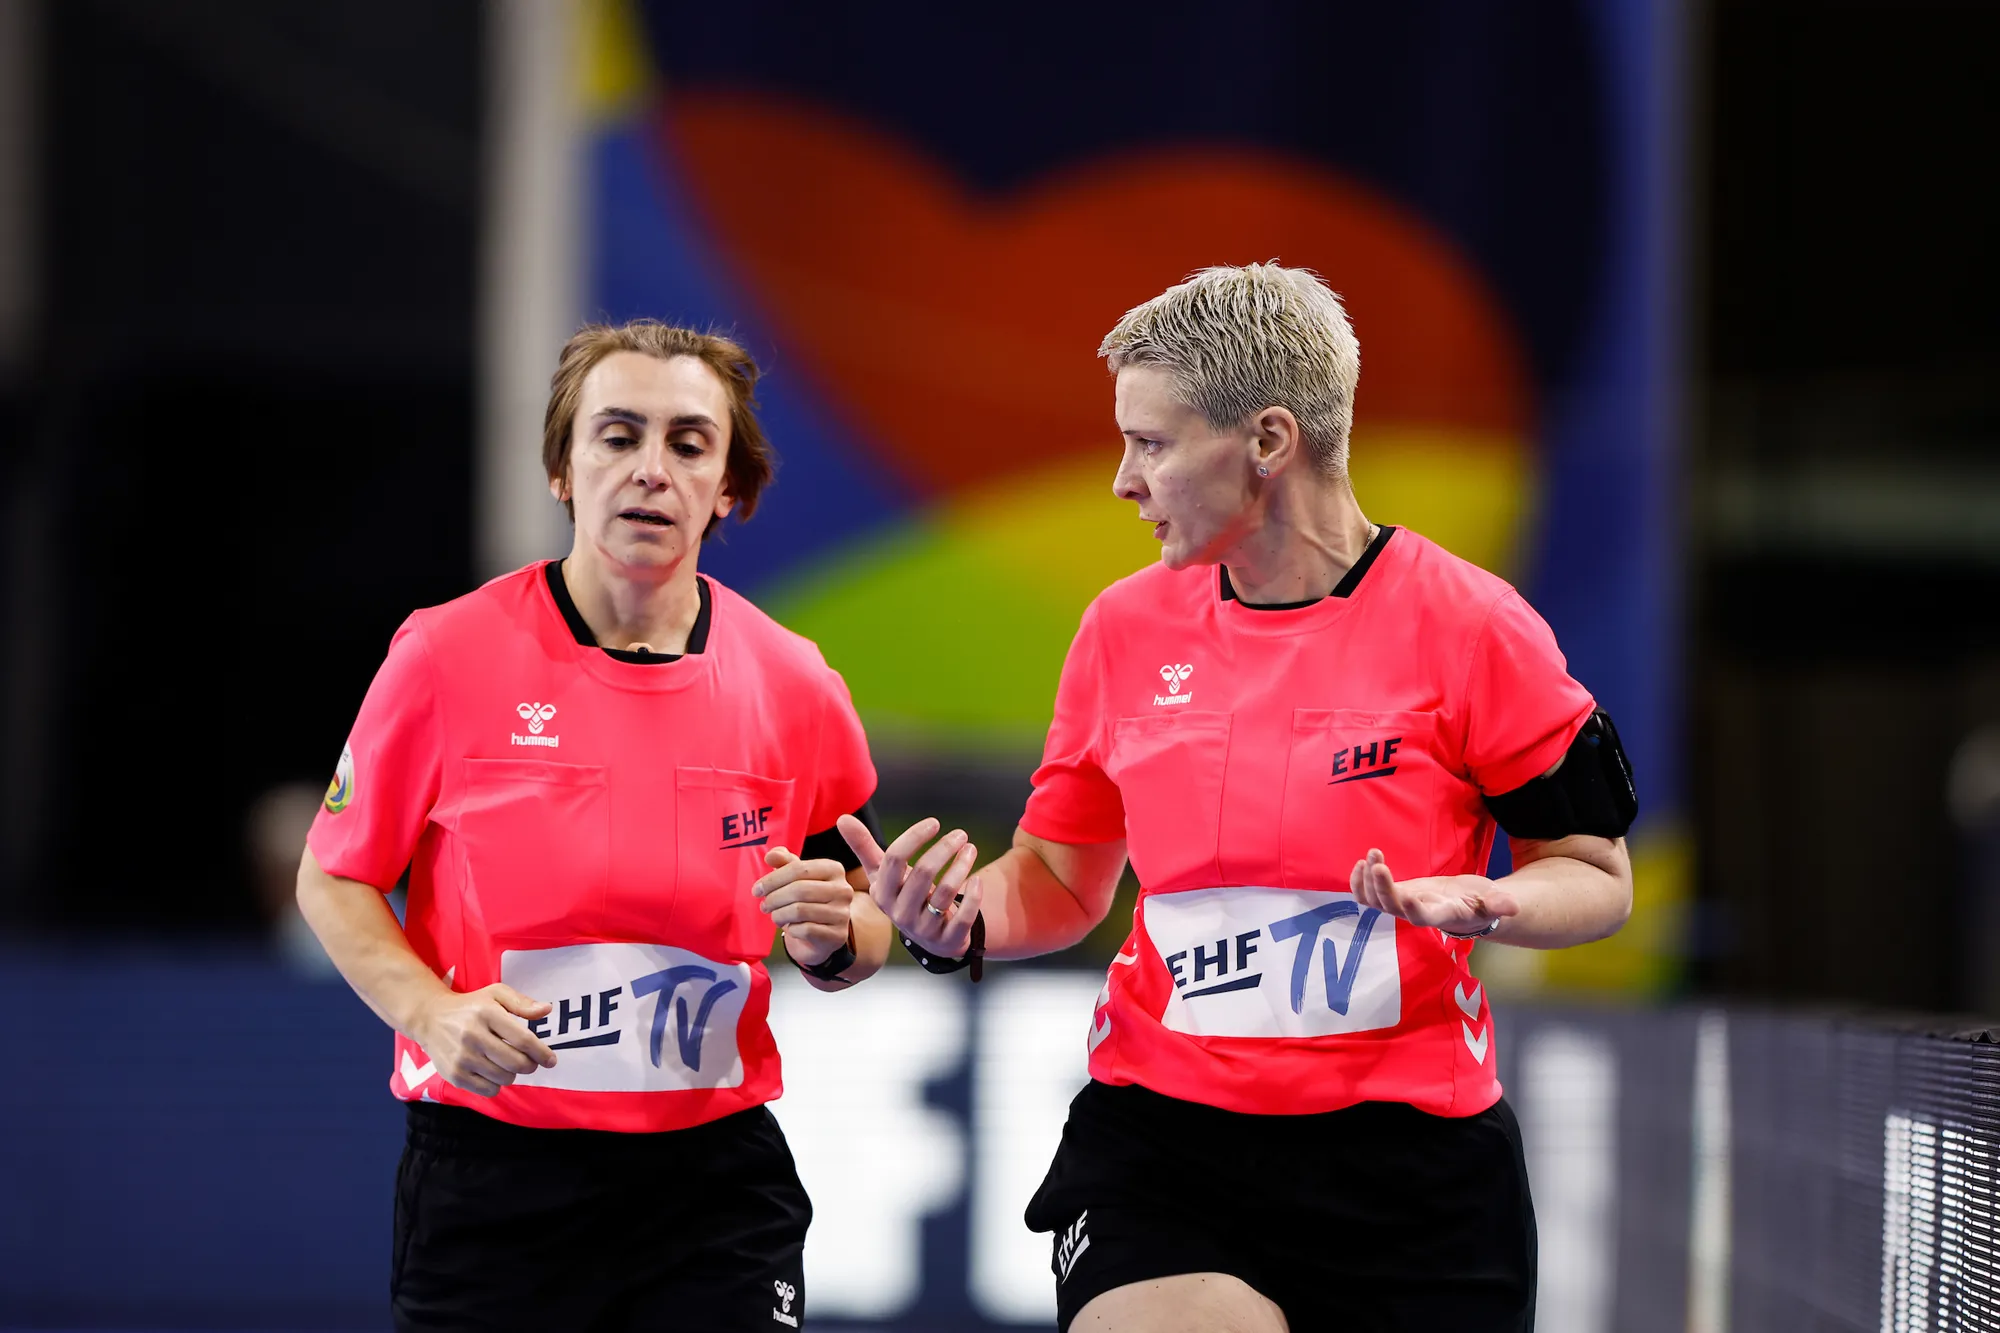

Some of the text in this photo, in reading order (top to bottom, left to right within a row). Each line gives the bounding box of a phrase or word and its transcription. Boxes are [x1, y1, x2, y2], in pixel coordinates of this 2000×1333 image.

[1153, 691, 1192, 706] hummel
[511, 732, 559, 748] hummel
[1331, 738, 1402, 776] EHF
[722, 806, 773, 842] EHF
[1166, 900, 1382, 1016] EHF TV
[631, 965, 738, 1072] TV
[1058, 1209, 1088, 1277] EHF
